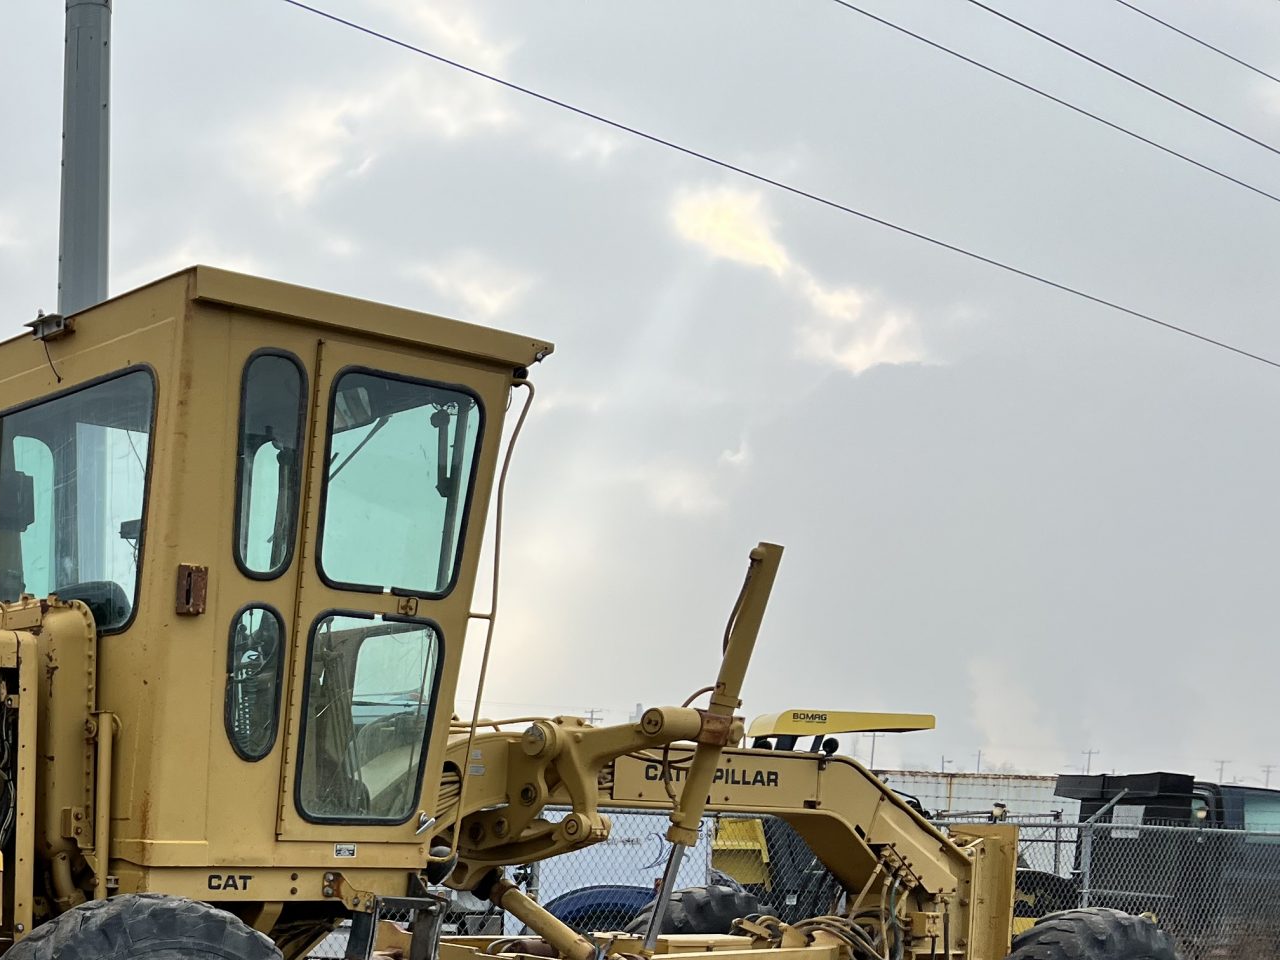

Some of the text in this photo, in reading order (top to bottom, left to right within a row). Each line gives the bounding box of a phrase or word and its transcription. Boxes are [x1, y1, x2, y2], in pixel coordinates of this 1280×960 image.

[792, 712, 827, 721] BOMAG
[645, 764, 779, 787] CATPILLAR
[208, 874, 252, 891] CAT
